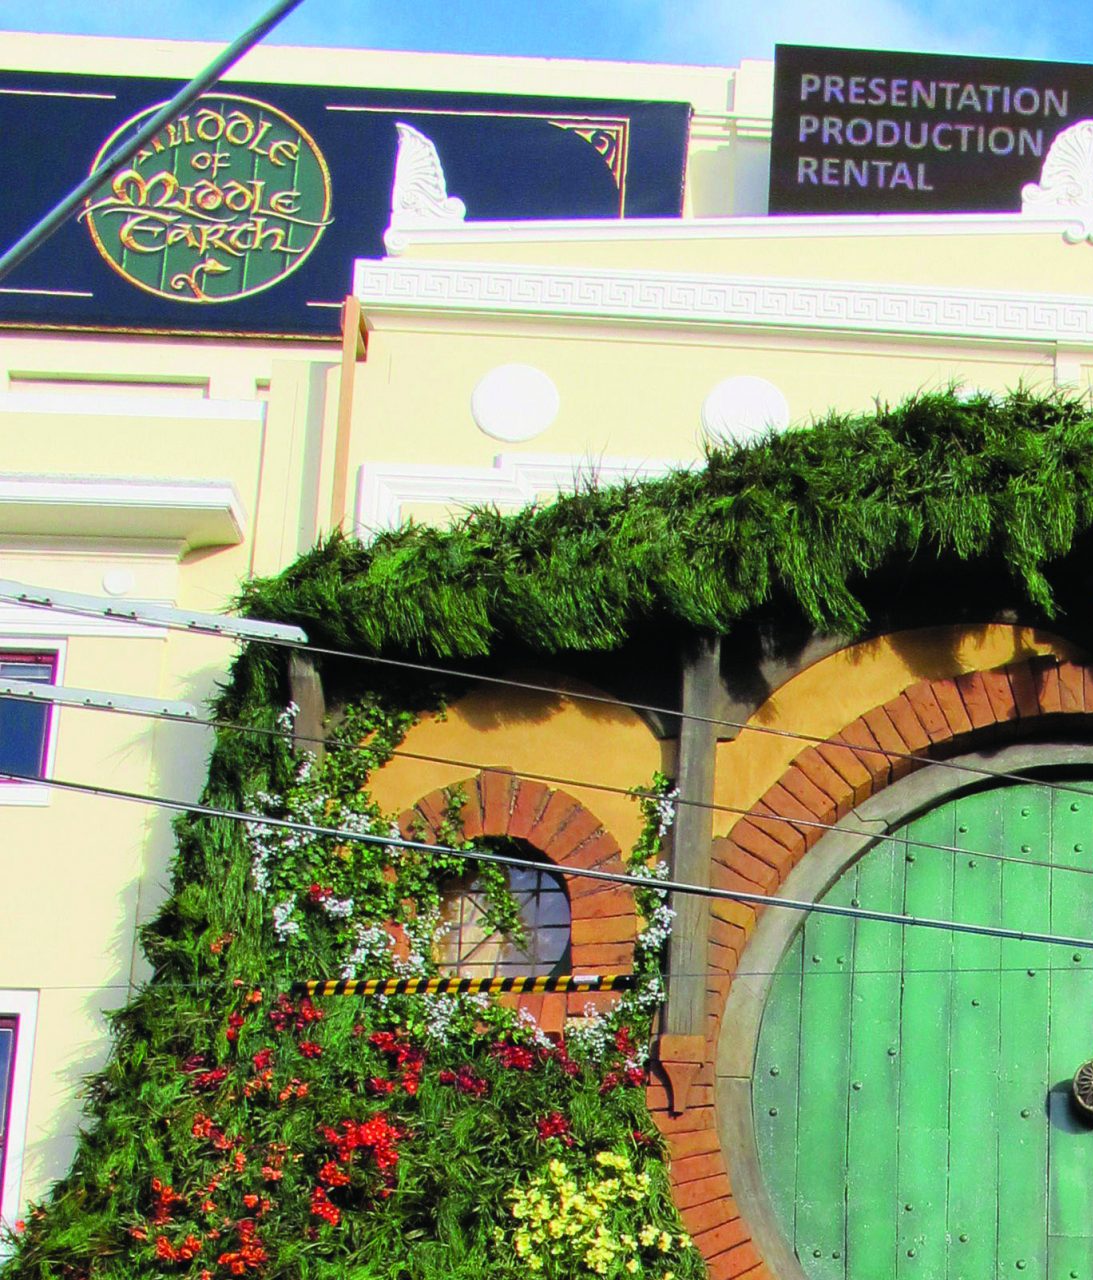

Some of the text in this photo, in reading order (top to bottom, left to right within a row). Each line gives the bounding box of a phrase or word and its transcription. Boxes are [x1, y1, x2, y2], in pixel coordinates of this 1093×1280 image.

[799, 73, 1069, 118] PRESENTATION
[798, 114, 1044, 157] PRODUCTION
[797, 157, 934, 191] RENTAL
